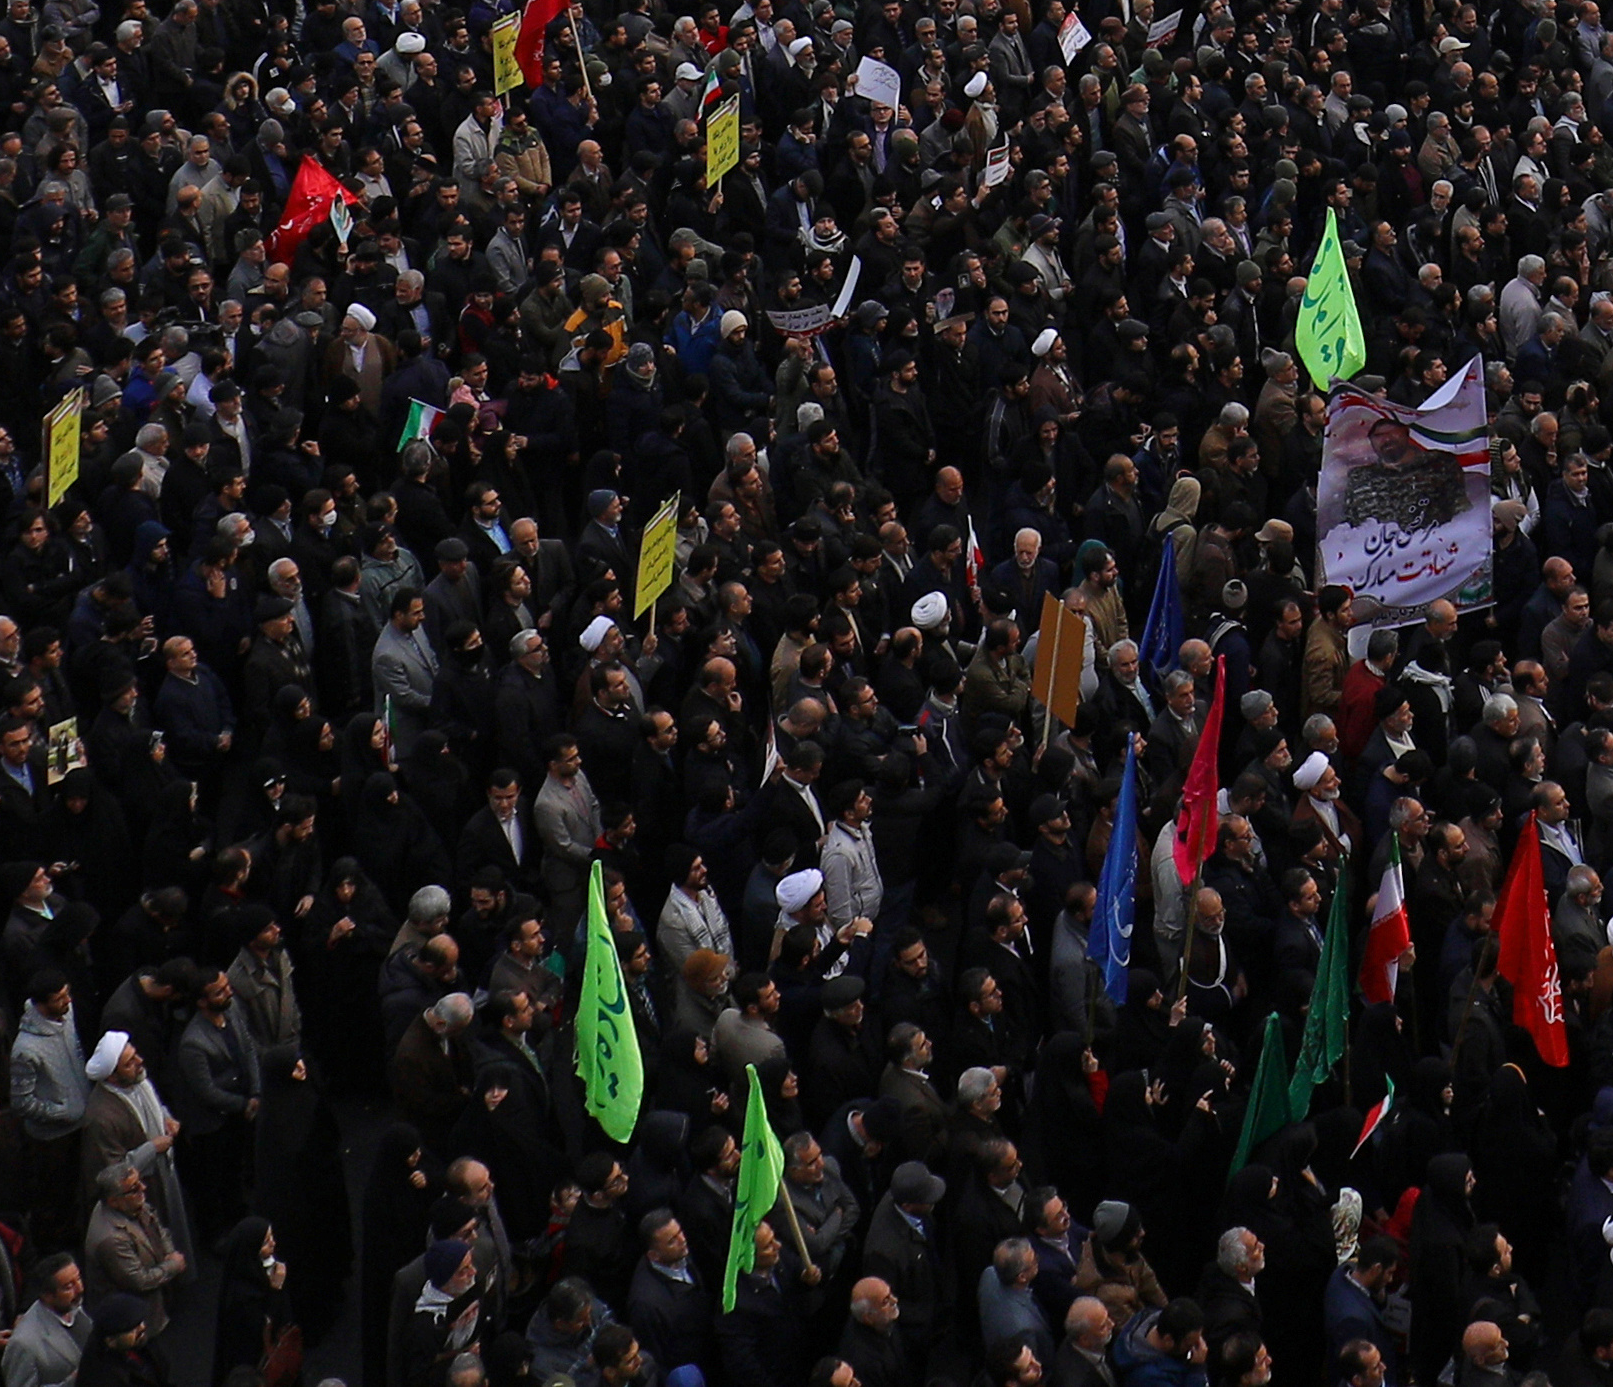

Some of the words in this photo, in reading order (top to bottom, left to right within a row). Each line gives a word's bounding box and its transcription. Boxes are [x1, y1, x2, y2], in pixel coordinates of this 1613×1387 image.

[1365, 523, 1397, 556] جان
[1396, 499, 1438, 548] مرتضی
[1353, 546, 1397, 603] مبارک
